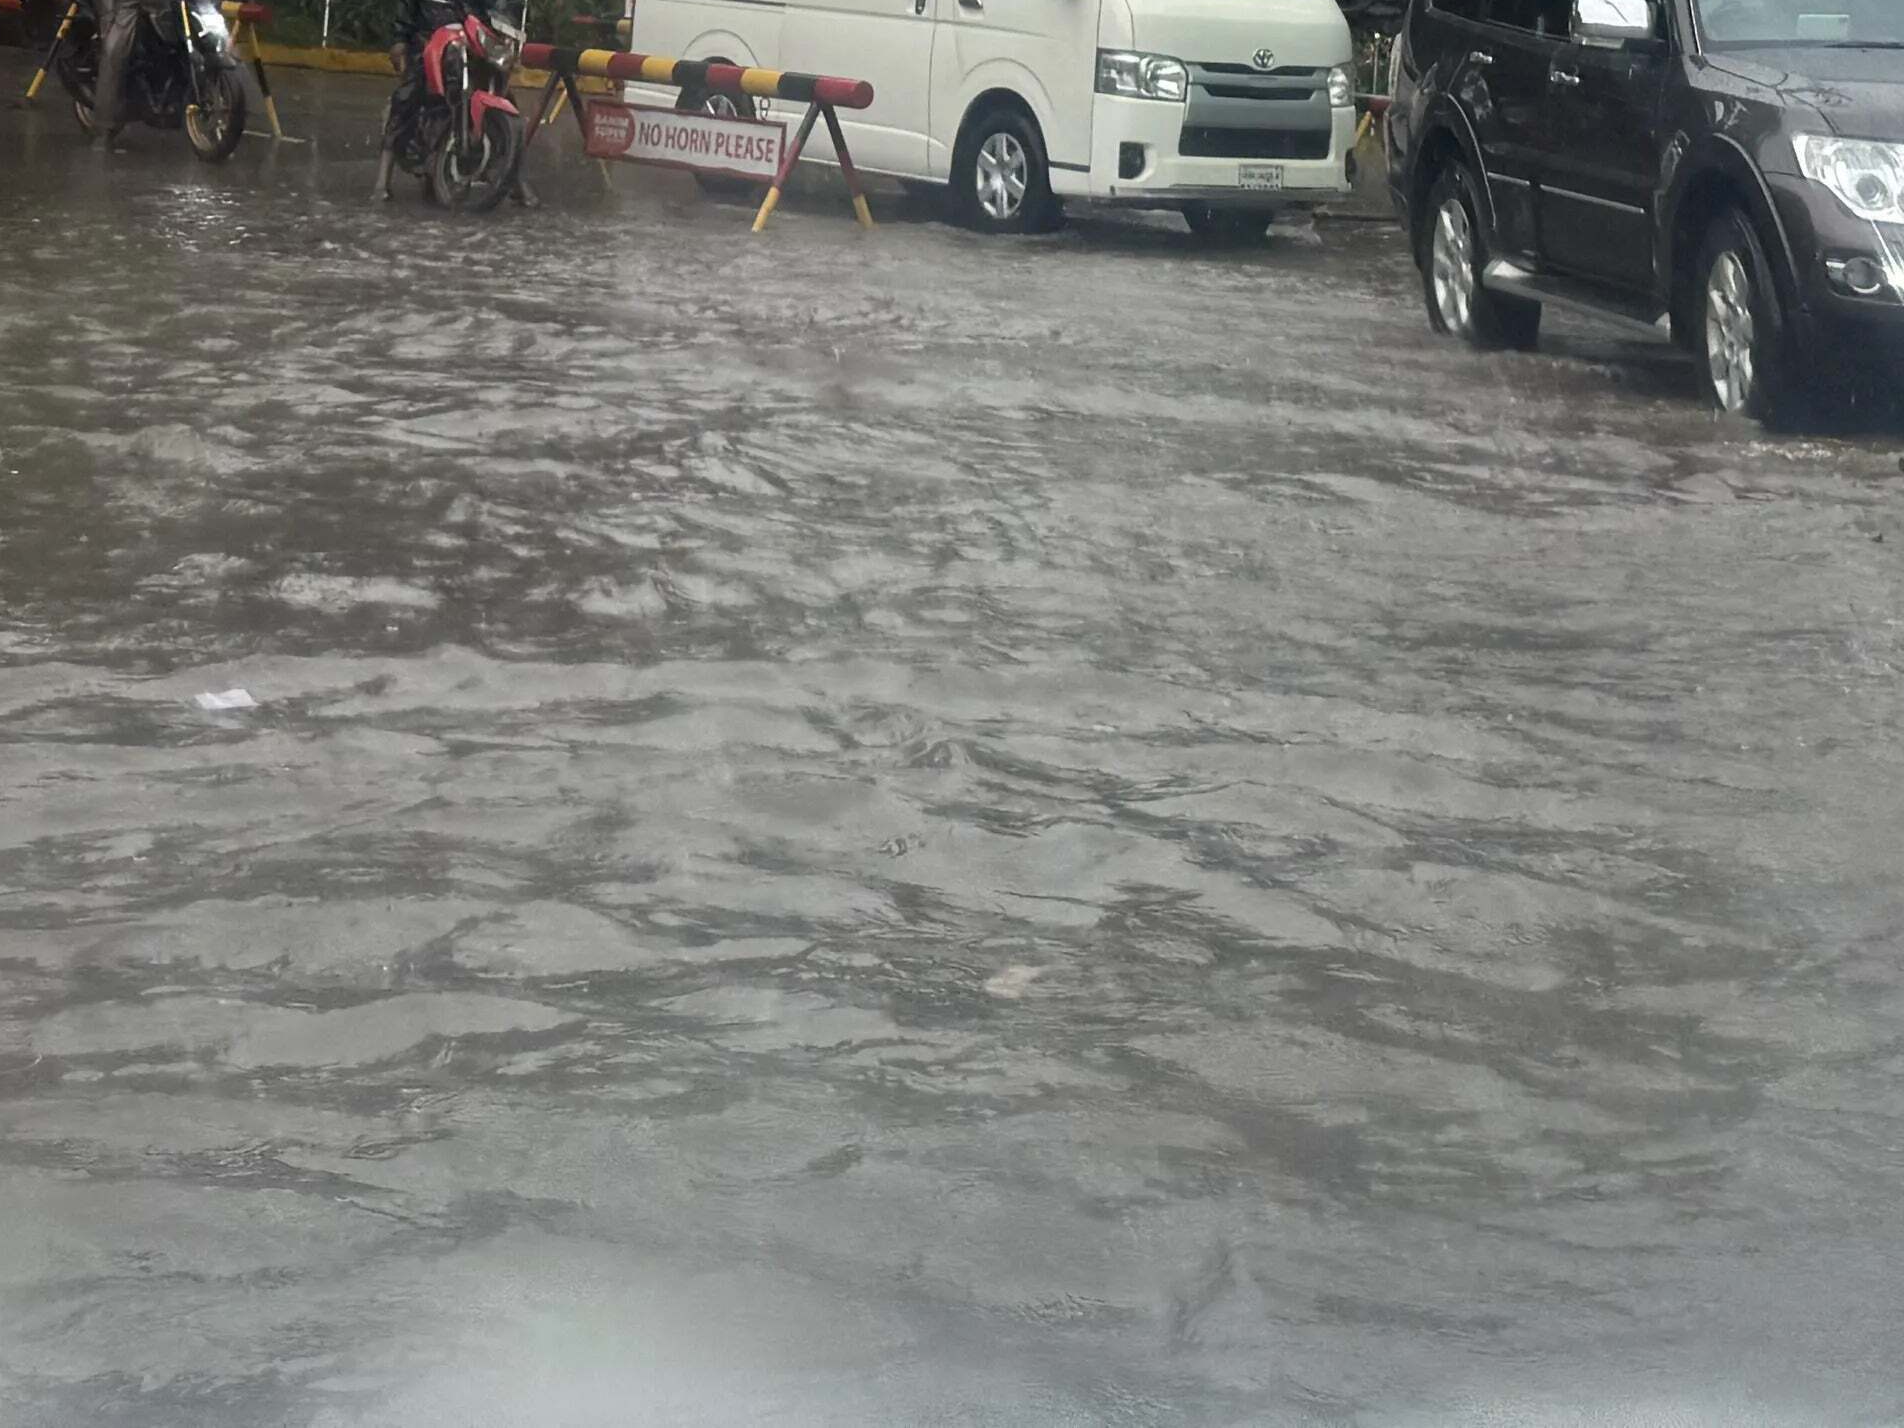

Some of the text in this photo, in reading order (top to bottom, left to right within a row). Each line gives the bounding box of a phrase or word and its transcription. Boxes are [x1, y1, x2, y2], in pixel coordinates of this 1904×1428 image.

[638, 121, 776, 163] NO HORN PLEASE
